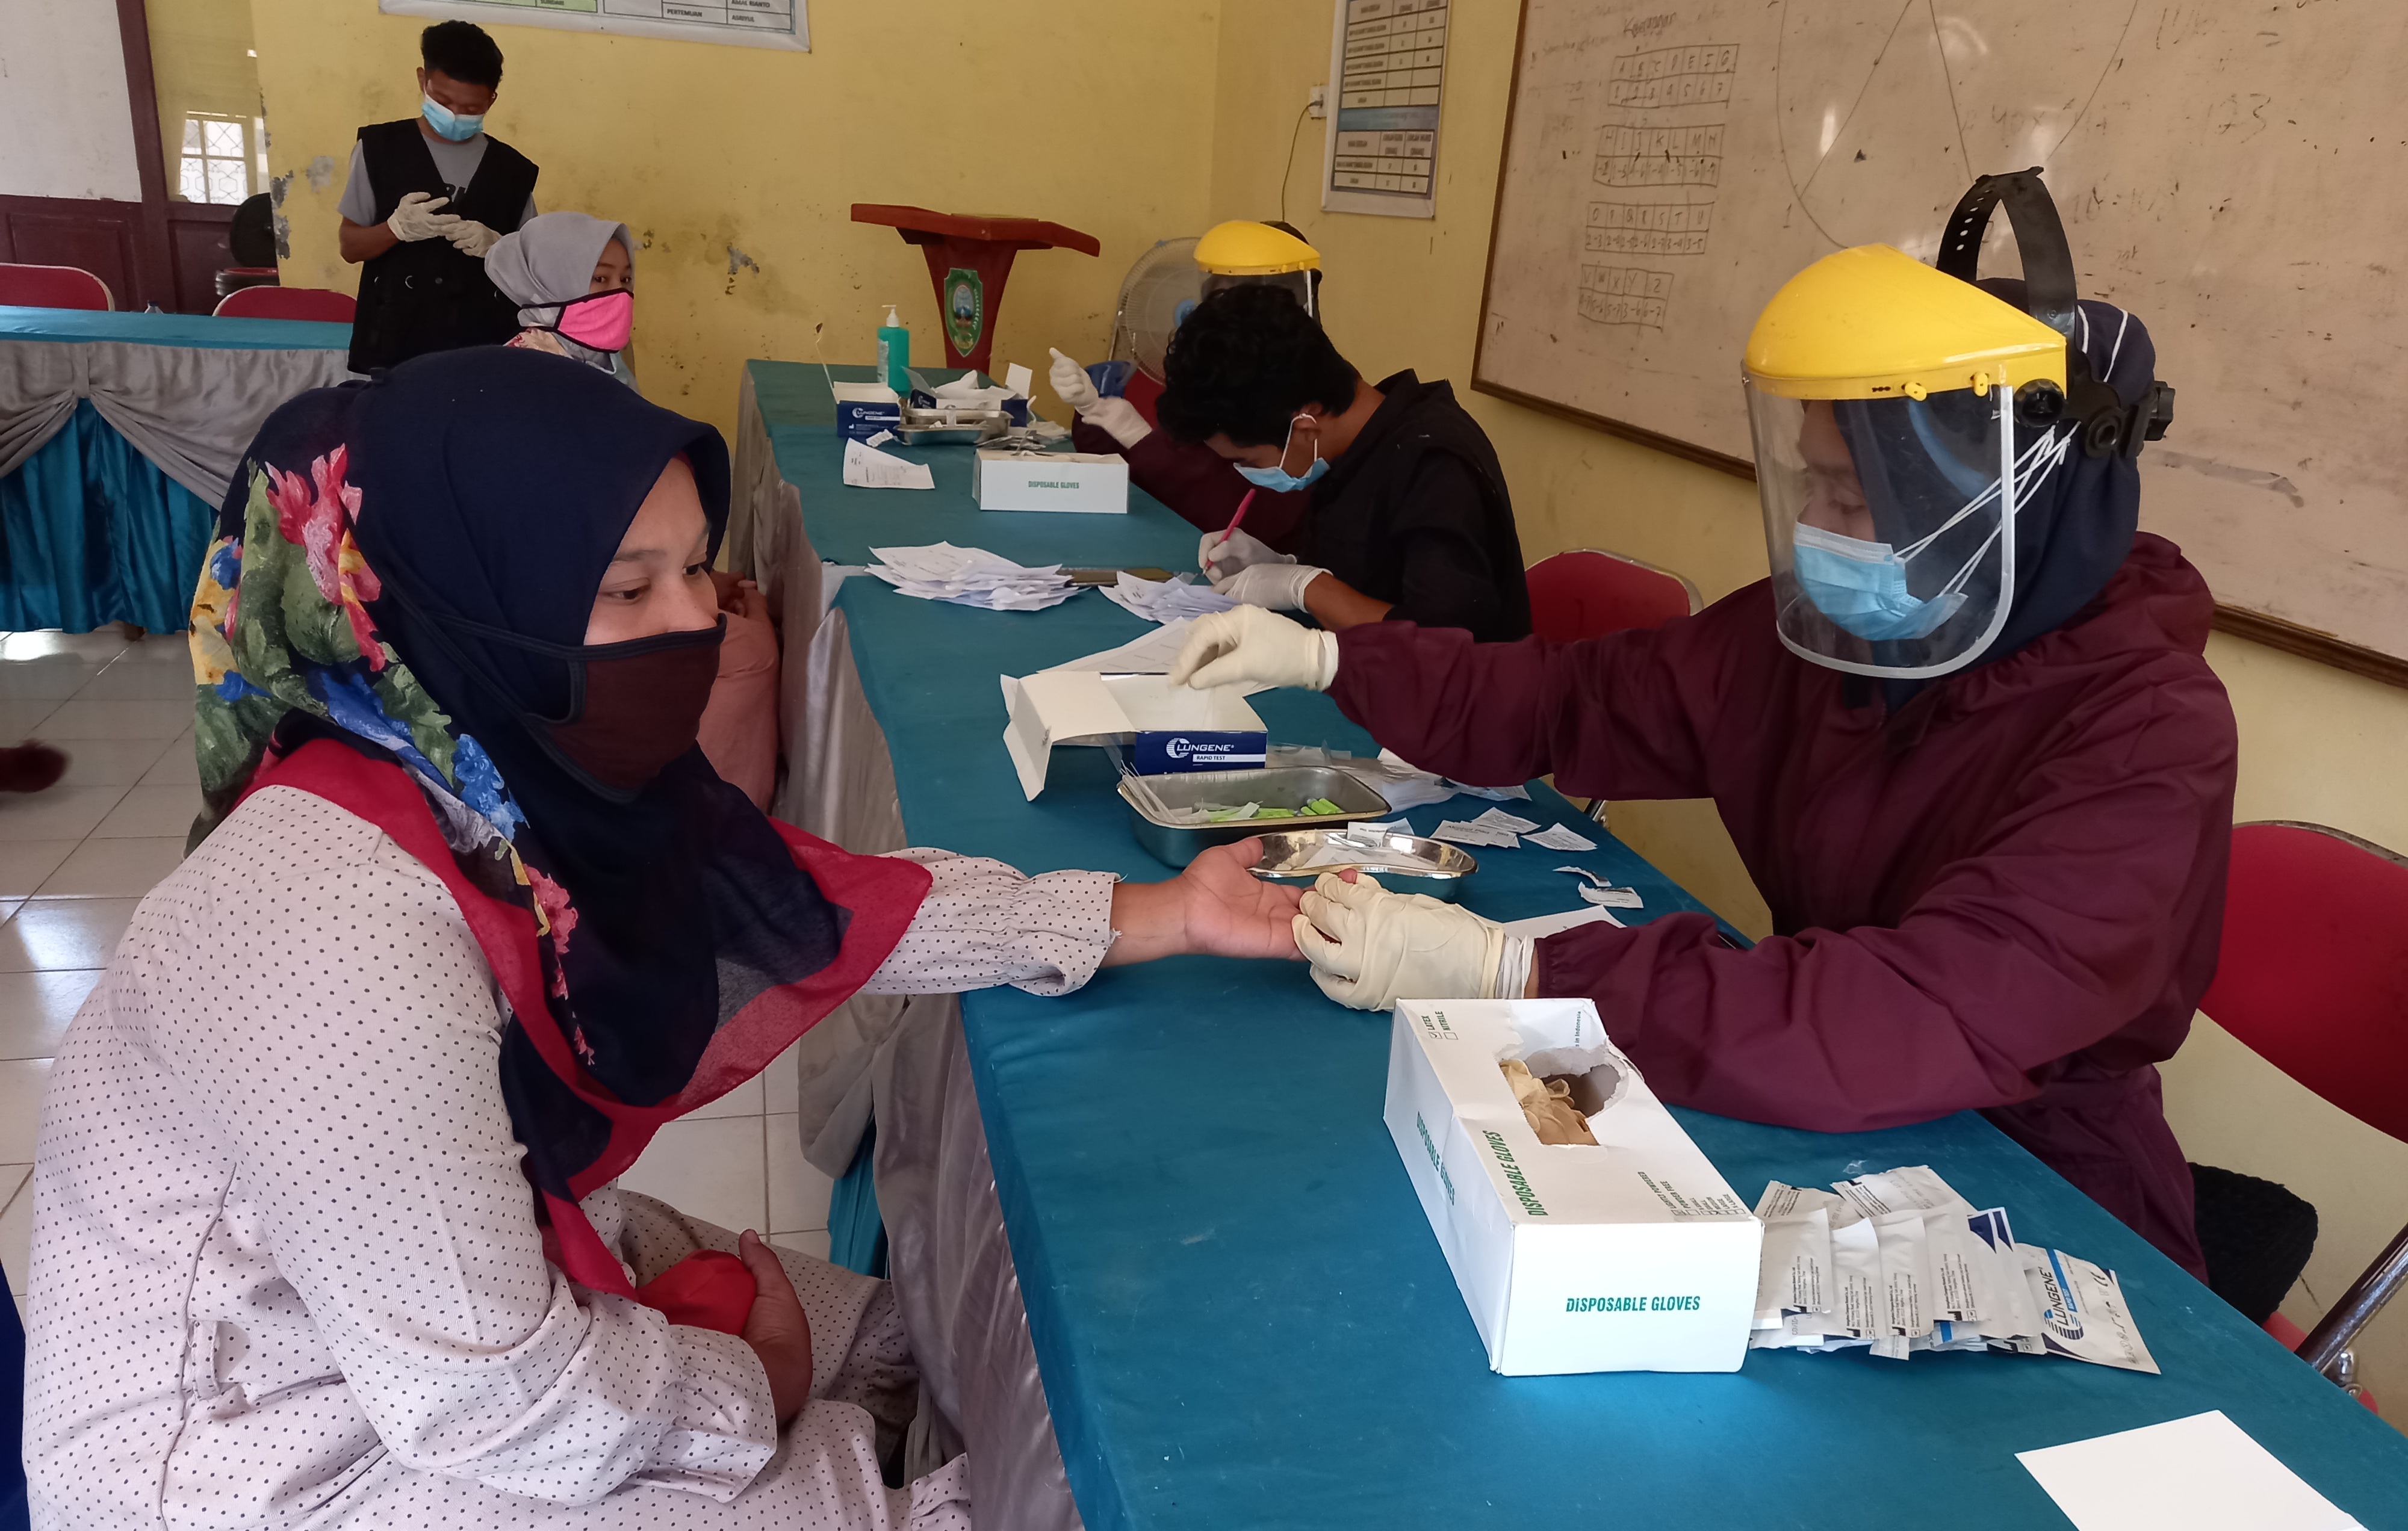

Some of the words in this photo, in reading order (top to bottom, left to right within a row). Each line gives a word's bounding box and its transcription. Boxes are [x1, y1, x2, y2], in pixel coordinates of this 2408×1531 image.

[1421, 1015, 1435, 1030] LATEX
[1435, 1011, 1451, 1031] NITRILE
[1417, 1111, 1440, 1173] DISPOSABLE
[1482, 1130, 1515, 1163] GLOVES
[1500, 1163, 1548, 1216] DISPOSABLE
[1637, 1171, 1662, 1194] POWDERED
[1660, 1181, 1675, 1192] FREE
[1566, 1297, 1648, 1313] DISPOSABLE
[1651, 1296, 1701, 1311] GLOVES
[2065, 1297, 2074, 1310] RAPID
